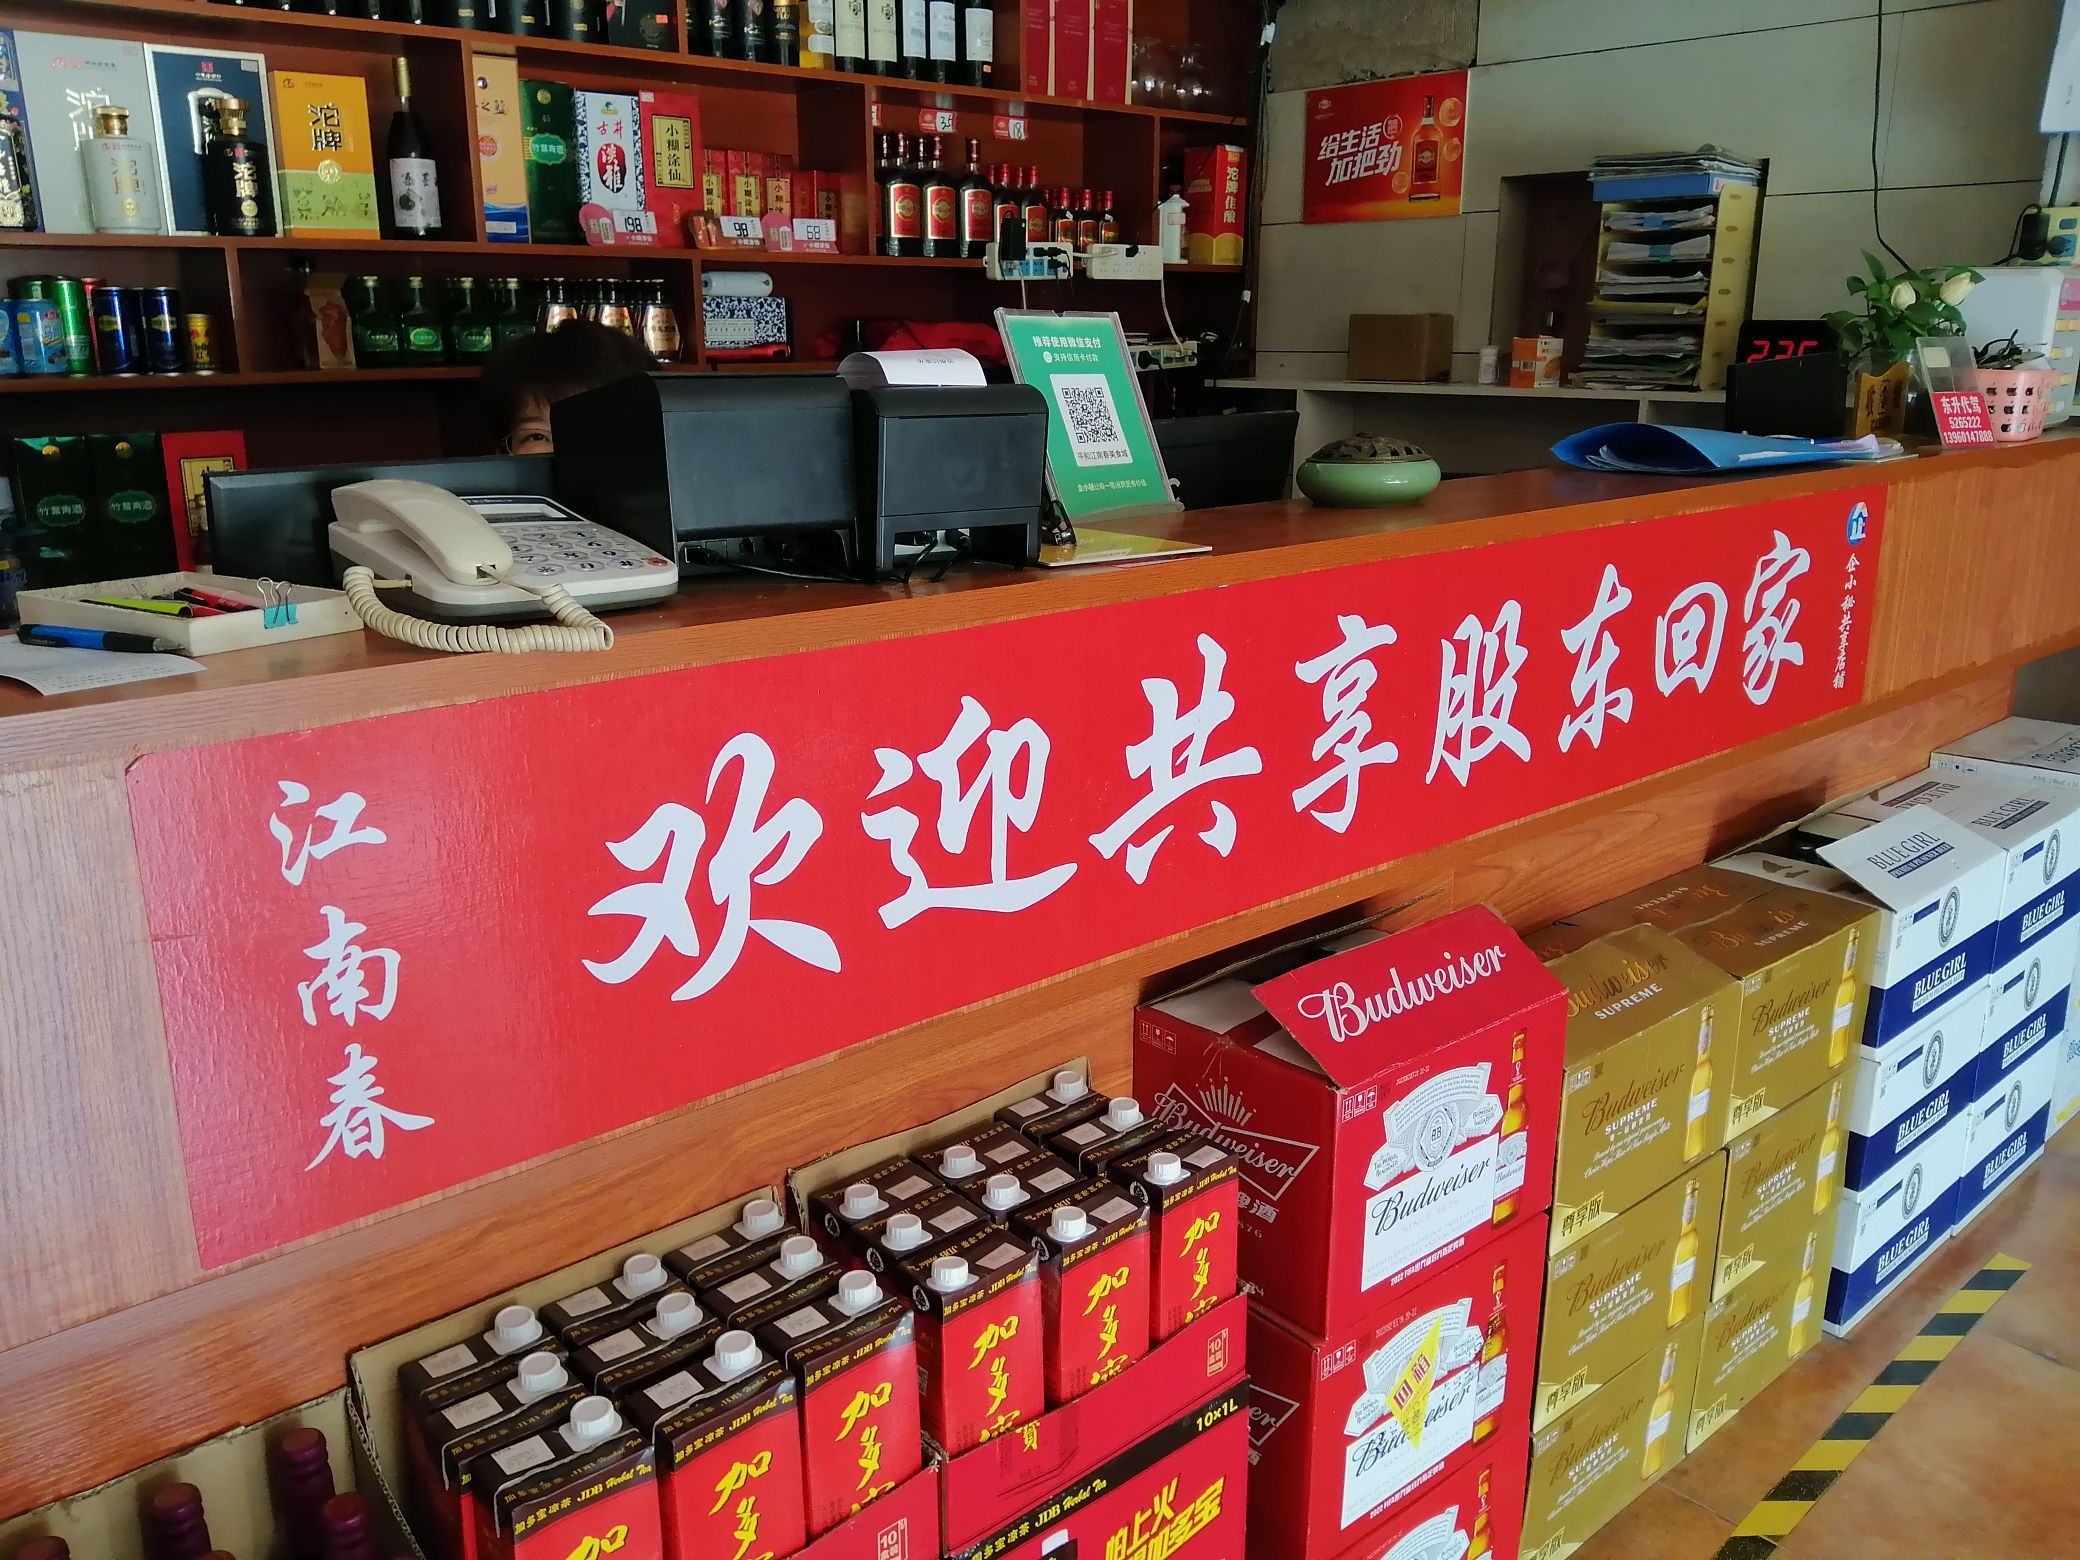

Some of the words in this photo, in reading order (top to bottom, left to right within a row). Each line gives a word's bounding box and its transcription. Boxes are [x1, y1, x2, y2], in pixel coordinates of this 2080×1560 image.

[307, 102, 342, 152] 沱牌
[597, 119, 624, 139] 古井
[1317, 122, 1383, 161] 给生活
[600, 143, 624, 193] 淡雅
[666, 124, 683, 182] 小糊涂仙
[1325, 140, 1403, 186] 加把劲
[232, 161, 259, 198] 沱牌
[624, 216, 643, 232] 198
[733, 222, 749, 238] 98
[806, 225, 821, 240] 68
[1032, 335, 1101, 349] 推荐使用微信支付
[1940, 395, 1982, 415] 东升代驾
[1948, 416, 1983, 430] 5265222
[582, 529, 1812, 1002] 欢迎共享股东回家
[1754, 919, 1810, 947] SUPREME
[269, 780, 436, 1173] 江南春
[1297, 945, 1507, 1043] Budweiser
[1594, 982, 1664, 1021] SUPREME
[1752, 978, 1832, 1037] Budweiser
[1768, 1006, 1812, 1038] SUPREME
[1582, 1063, 1685, 1136] Budweiser
[1604, 1098, 1659, 1136] SUPREME
[1732, 1089, 1765, 1126] 尊享版
[1163, 1186, 1195, 1209] 加多宝凉茶
[1196, 1176, 1211, 1193] JDB
[1210, 1169, 1228, 1184] Herbal
[1227, 1166, 1238, 1178] Tea
[1741, 1132, 1817, 1200] Budweiser
[1756, 1161, 1798, 1196] SUPREME
[1371, 1157, 1491, 1236] Budweiser
[1562, 1192, 1604, 1237] 尊享版
[1063, 1241, 1100, 1267] 加多宝凉茶
[1102, 1230, 1120, 1247] JDB
[1119, 1222, 1138, 1238] Herbal
[1137, 1219, 1148, 1231] Tea
[1722, 1247, 1754, 1284] 尊享版
[943, 1289, 985, 1317] 加多宝凉茶
[988, 1275, 1007, 1294] JDB
[1005, 1267, 1027, 1285] Herbal
[1026, 1263, 1038, 1276] Tea
[1567, 1237, 1667, 1317] Budweiser
[1588, 1271, 1643, 1313] SUPREME
[1715, 1281, 1791, 1352] Budweiser
[1730, 1311, 1772, 1349] SUPREME
[805, 1354, 850, 1387] 加多宝凉茶
[852, 1342, 875, 1361] JDB
[874, 1331, 898, 1348] Herbal
[898, 1324, 913, 1337] Tea
[1208, 1337, 1222, 1352] 10
[1546, 1370, 1587, 1414] 尊享版
[674, 1426, 725, 1464] 加多宝凉茶
[728, 1411, 752, 1431] JDB
[752, 1396, 778, 1418] Herbal
[778, 1392, 794, 1405] Tea
[1695, 1398, 1725, 1435] 尊享版
[1548, 1396, 1646, 1487] Budweiser
[1568, 1432, 1620, 1480] SUPREME
[514, 1496, 573, 1536] 加多宝凉茶
[576, 1482, 605, 1502] JDB
[605, 1468, 635, 1489] Herbal
[635, 1463, 653, 1476] Tea
[709, 1450, 774, 1560] 加多
[1034, 1504, 1061, 1527] JDB
[1062, 1488, 1091, 1511] Herbal
[1091, 1478, 1108, 1494] Tea
[1105, 1475, 1179, 1560] 怕上火
[880, 1531, 898, 1547] 10
